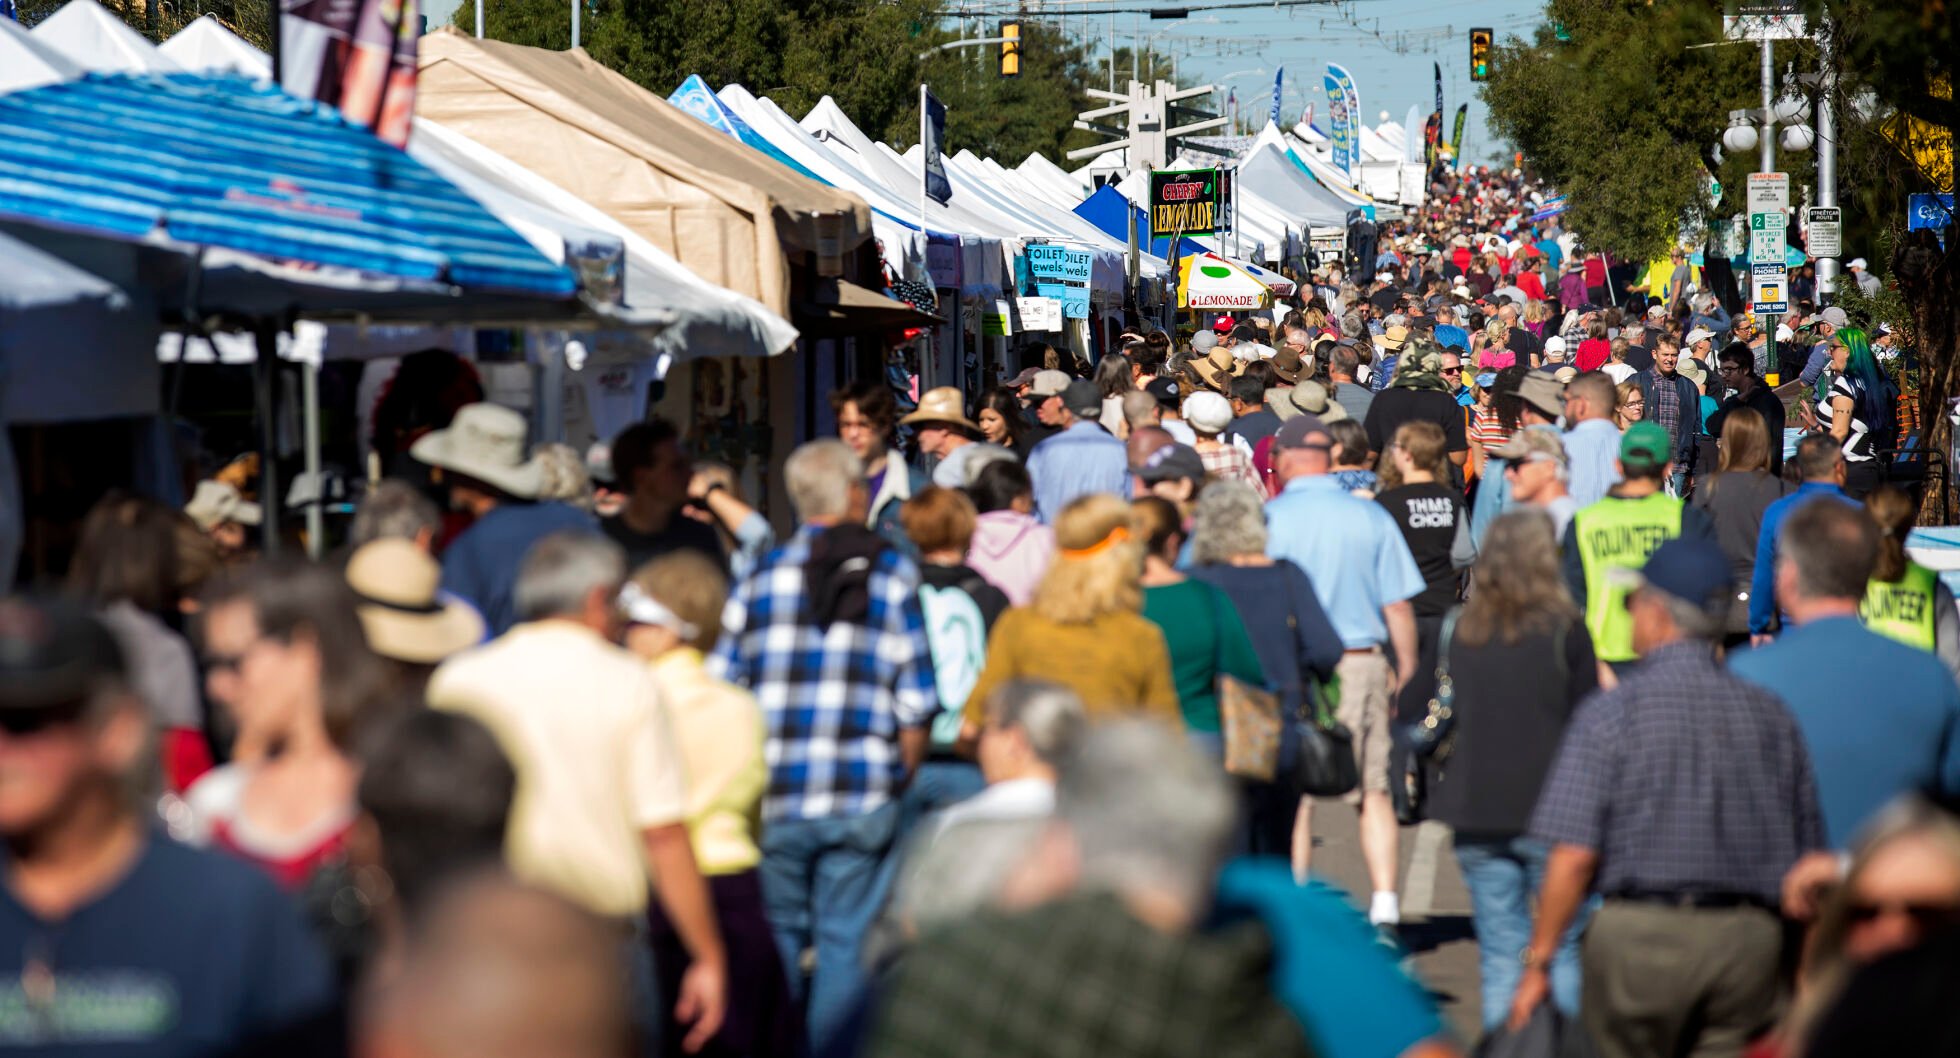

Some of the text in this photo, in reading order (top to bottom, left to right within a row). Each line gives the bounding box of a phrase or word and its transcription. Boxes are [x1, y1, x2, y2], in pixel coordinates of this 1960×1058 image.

[1163, 182, 1204, 200] CHERRY
[1153, 201, 1214, 232] LEMONADE
[1755, 216, 1762, 227] 2
[1027, 248, 1064, 259] TOILET
[1065, 253, 1089, 264] OILET
[1198, 296, 1253, 305] LEMONADE
[1406, 497, 1453, 513] THMS
[1408, 513, 1453, 528] CHOIR
